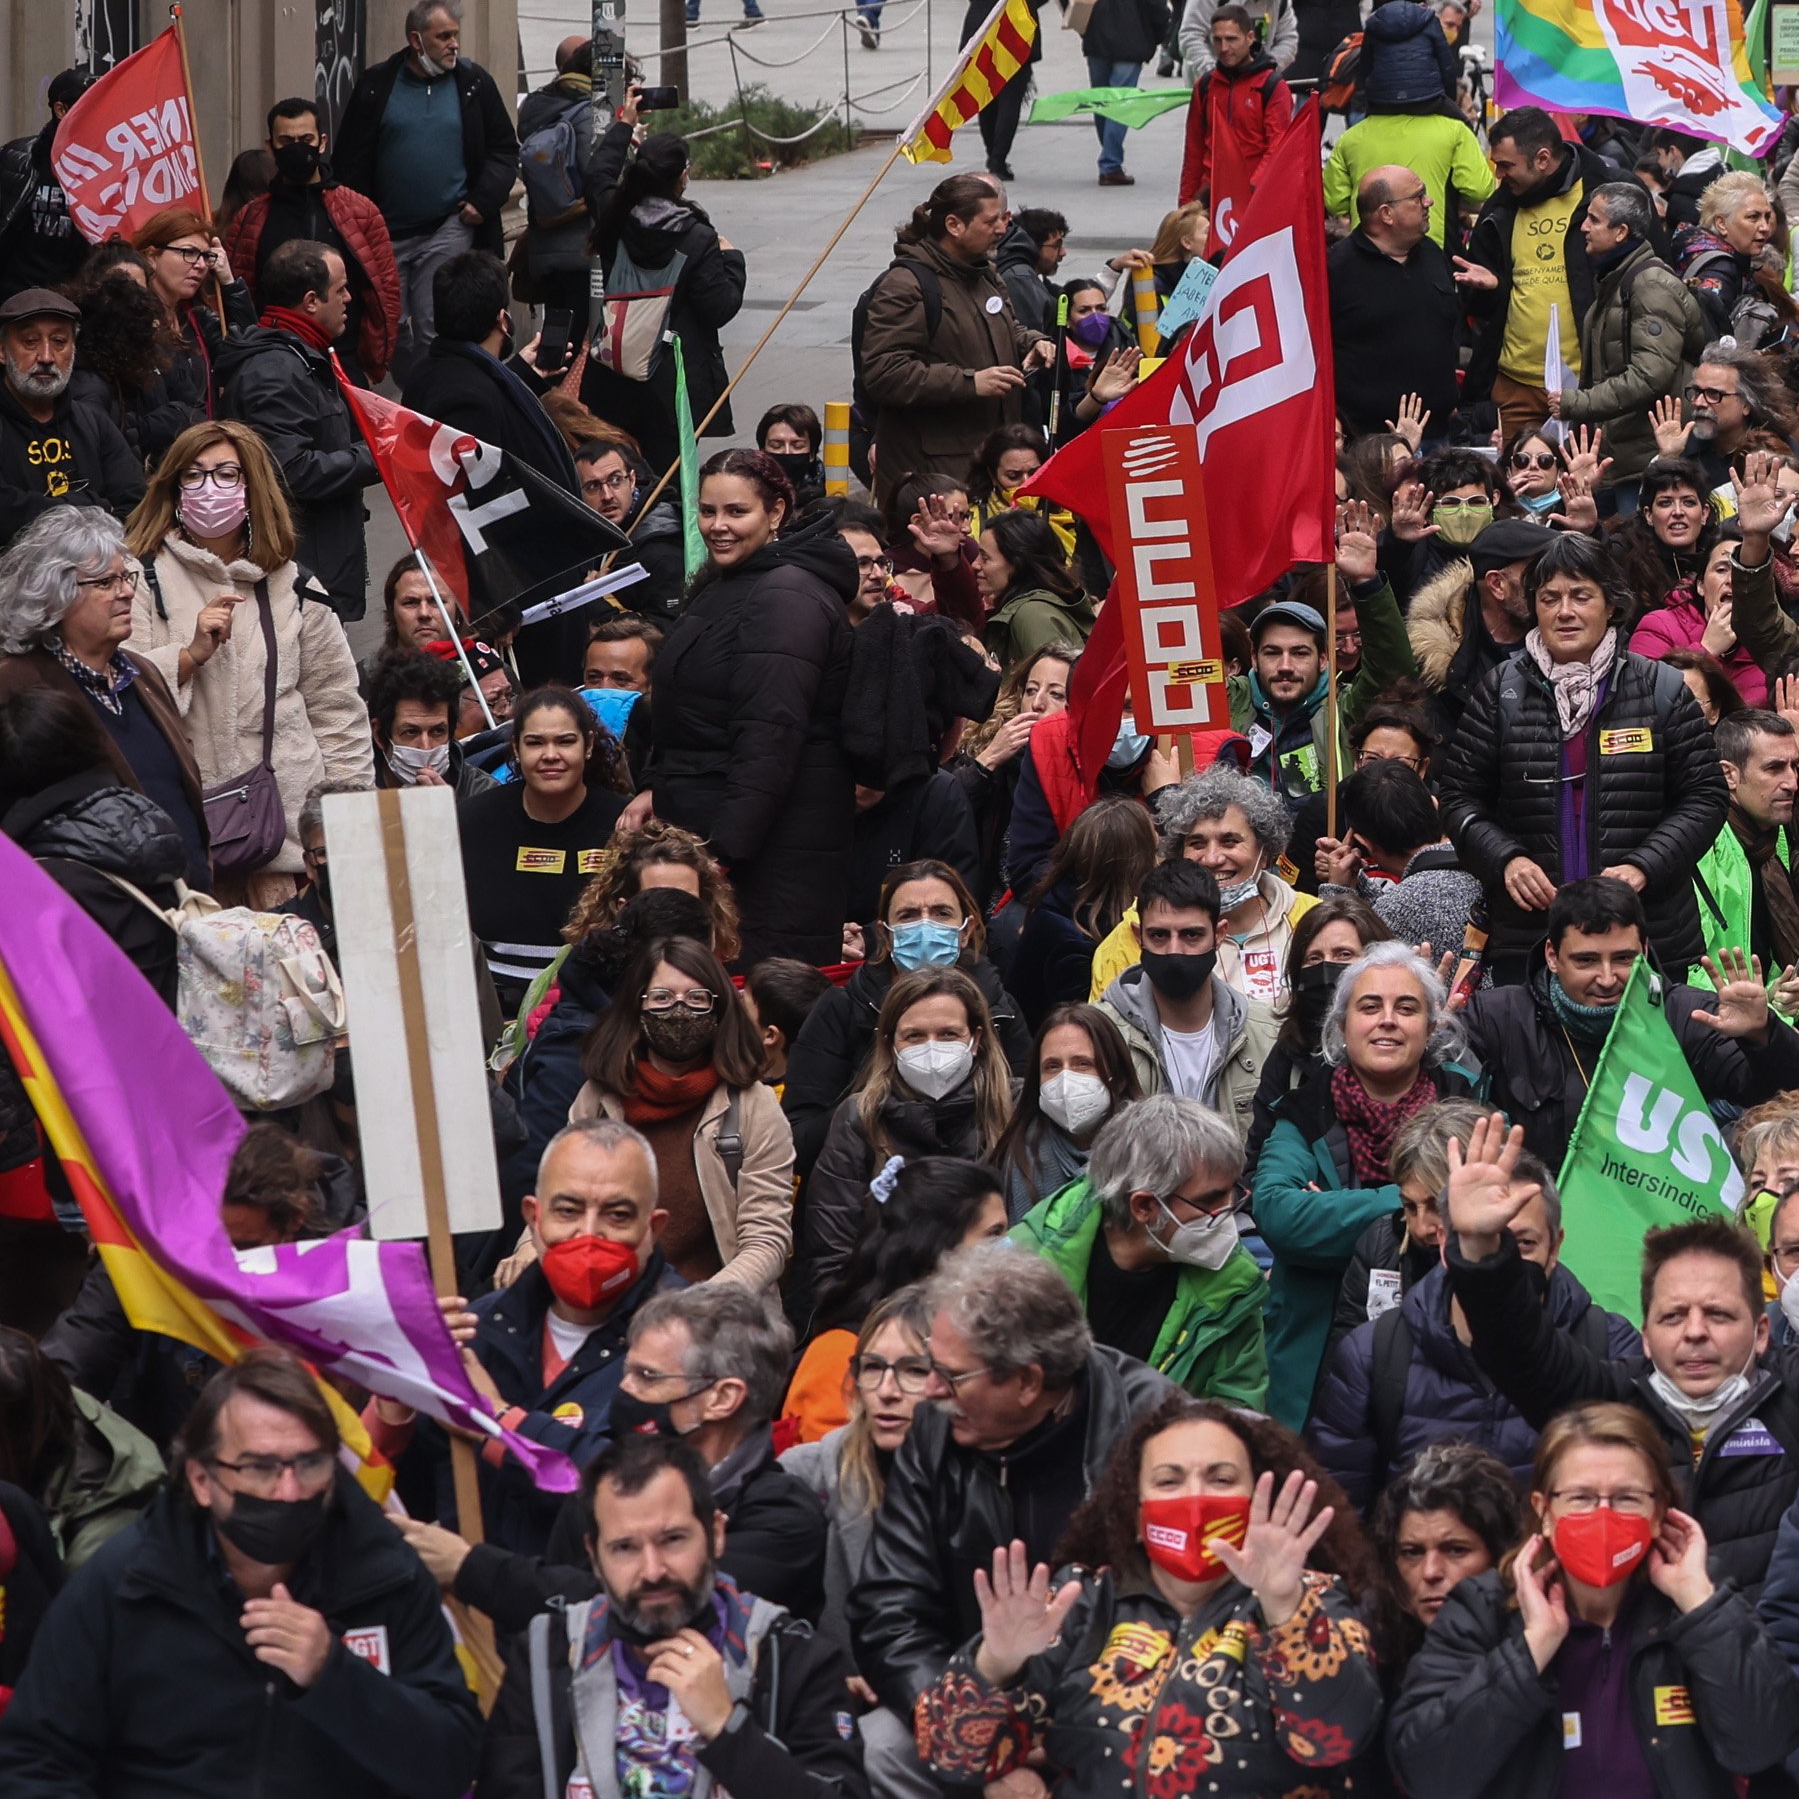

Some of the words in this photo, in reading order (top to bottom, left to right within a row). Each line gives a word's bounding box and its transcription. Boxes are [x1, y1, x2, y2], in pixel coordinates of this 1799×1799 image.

[1527, 217, 1568, 238] SOS
[1124, 479, 1212, 727] CCOO
[1250, 954, 1275, 968] UGT
